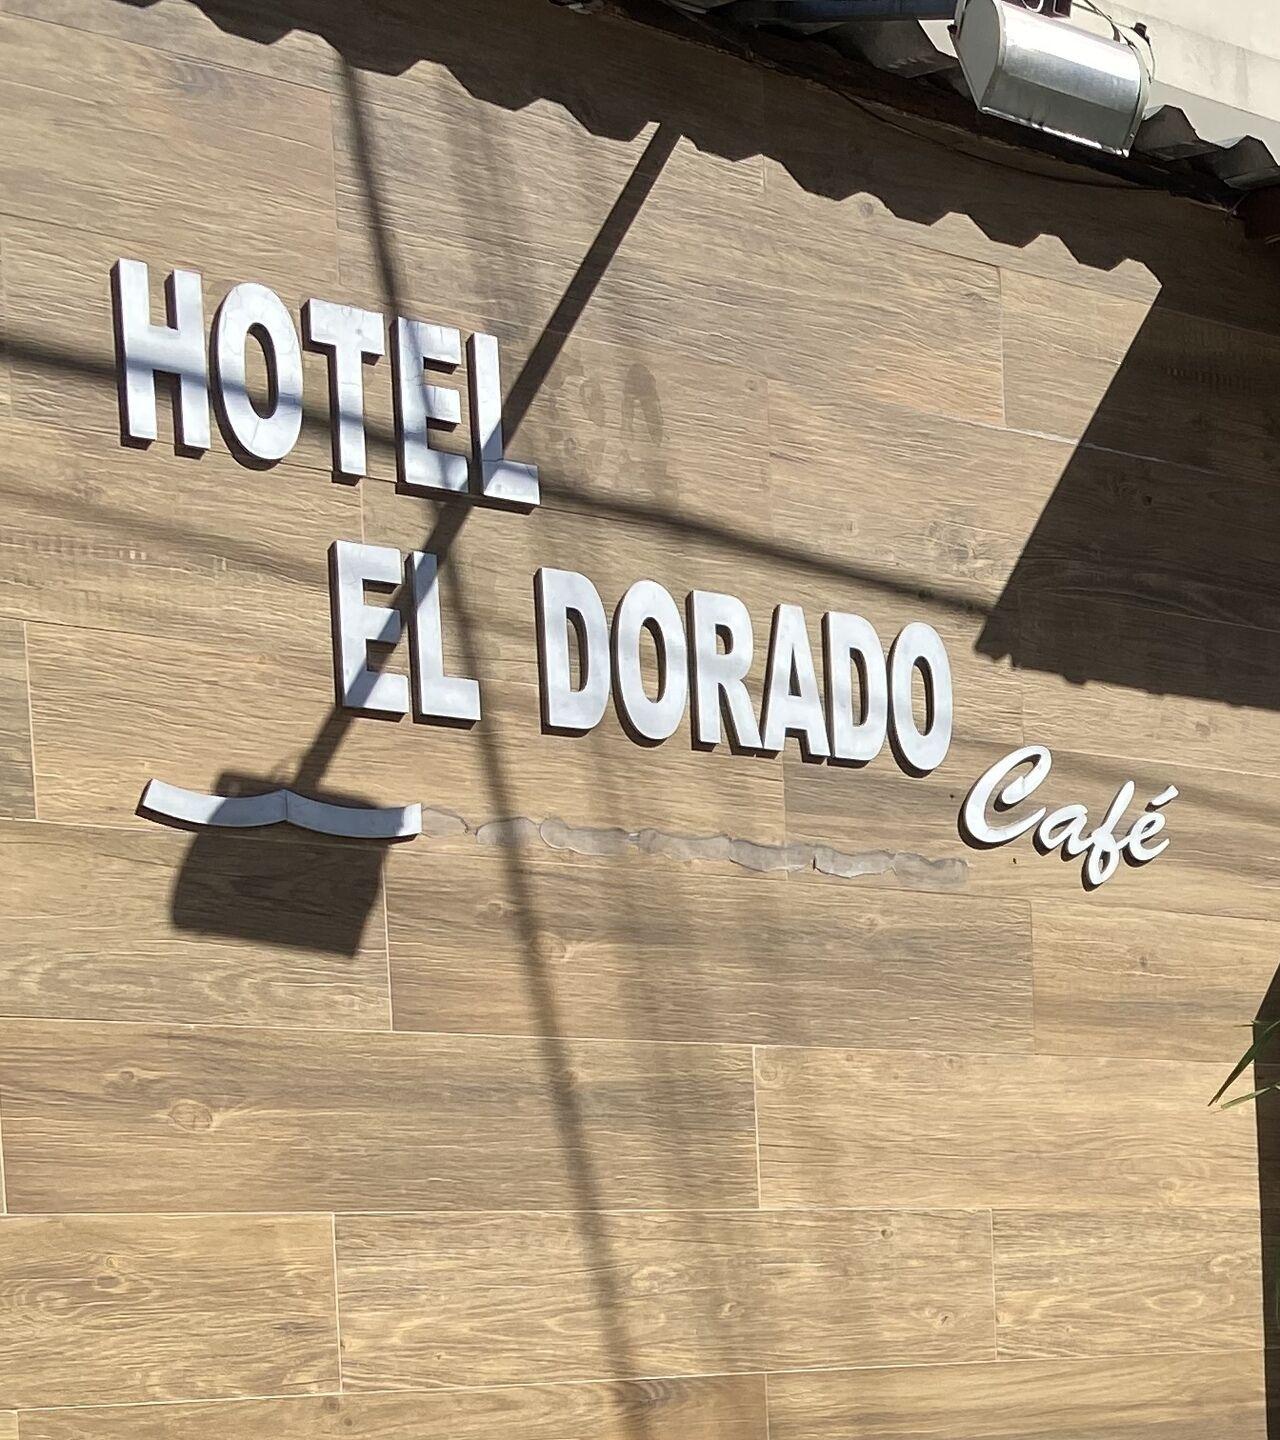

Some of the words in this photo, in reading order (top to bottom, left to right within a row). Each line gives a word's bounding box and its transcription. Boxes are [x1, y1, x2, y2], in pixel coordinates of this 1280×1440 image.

[112, 256, 540, 512] HOTEL
[328, 539, 482, 724] EL
[534, 565, 956, 774] DORADO
[960, 743, 1180, 890] Café
